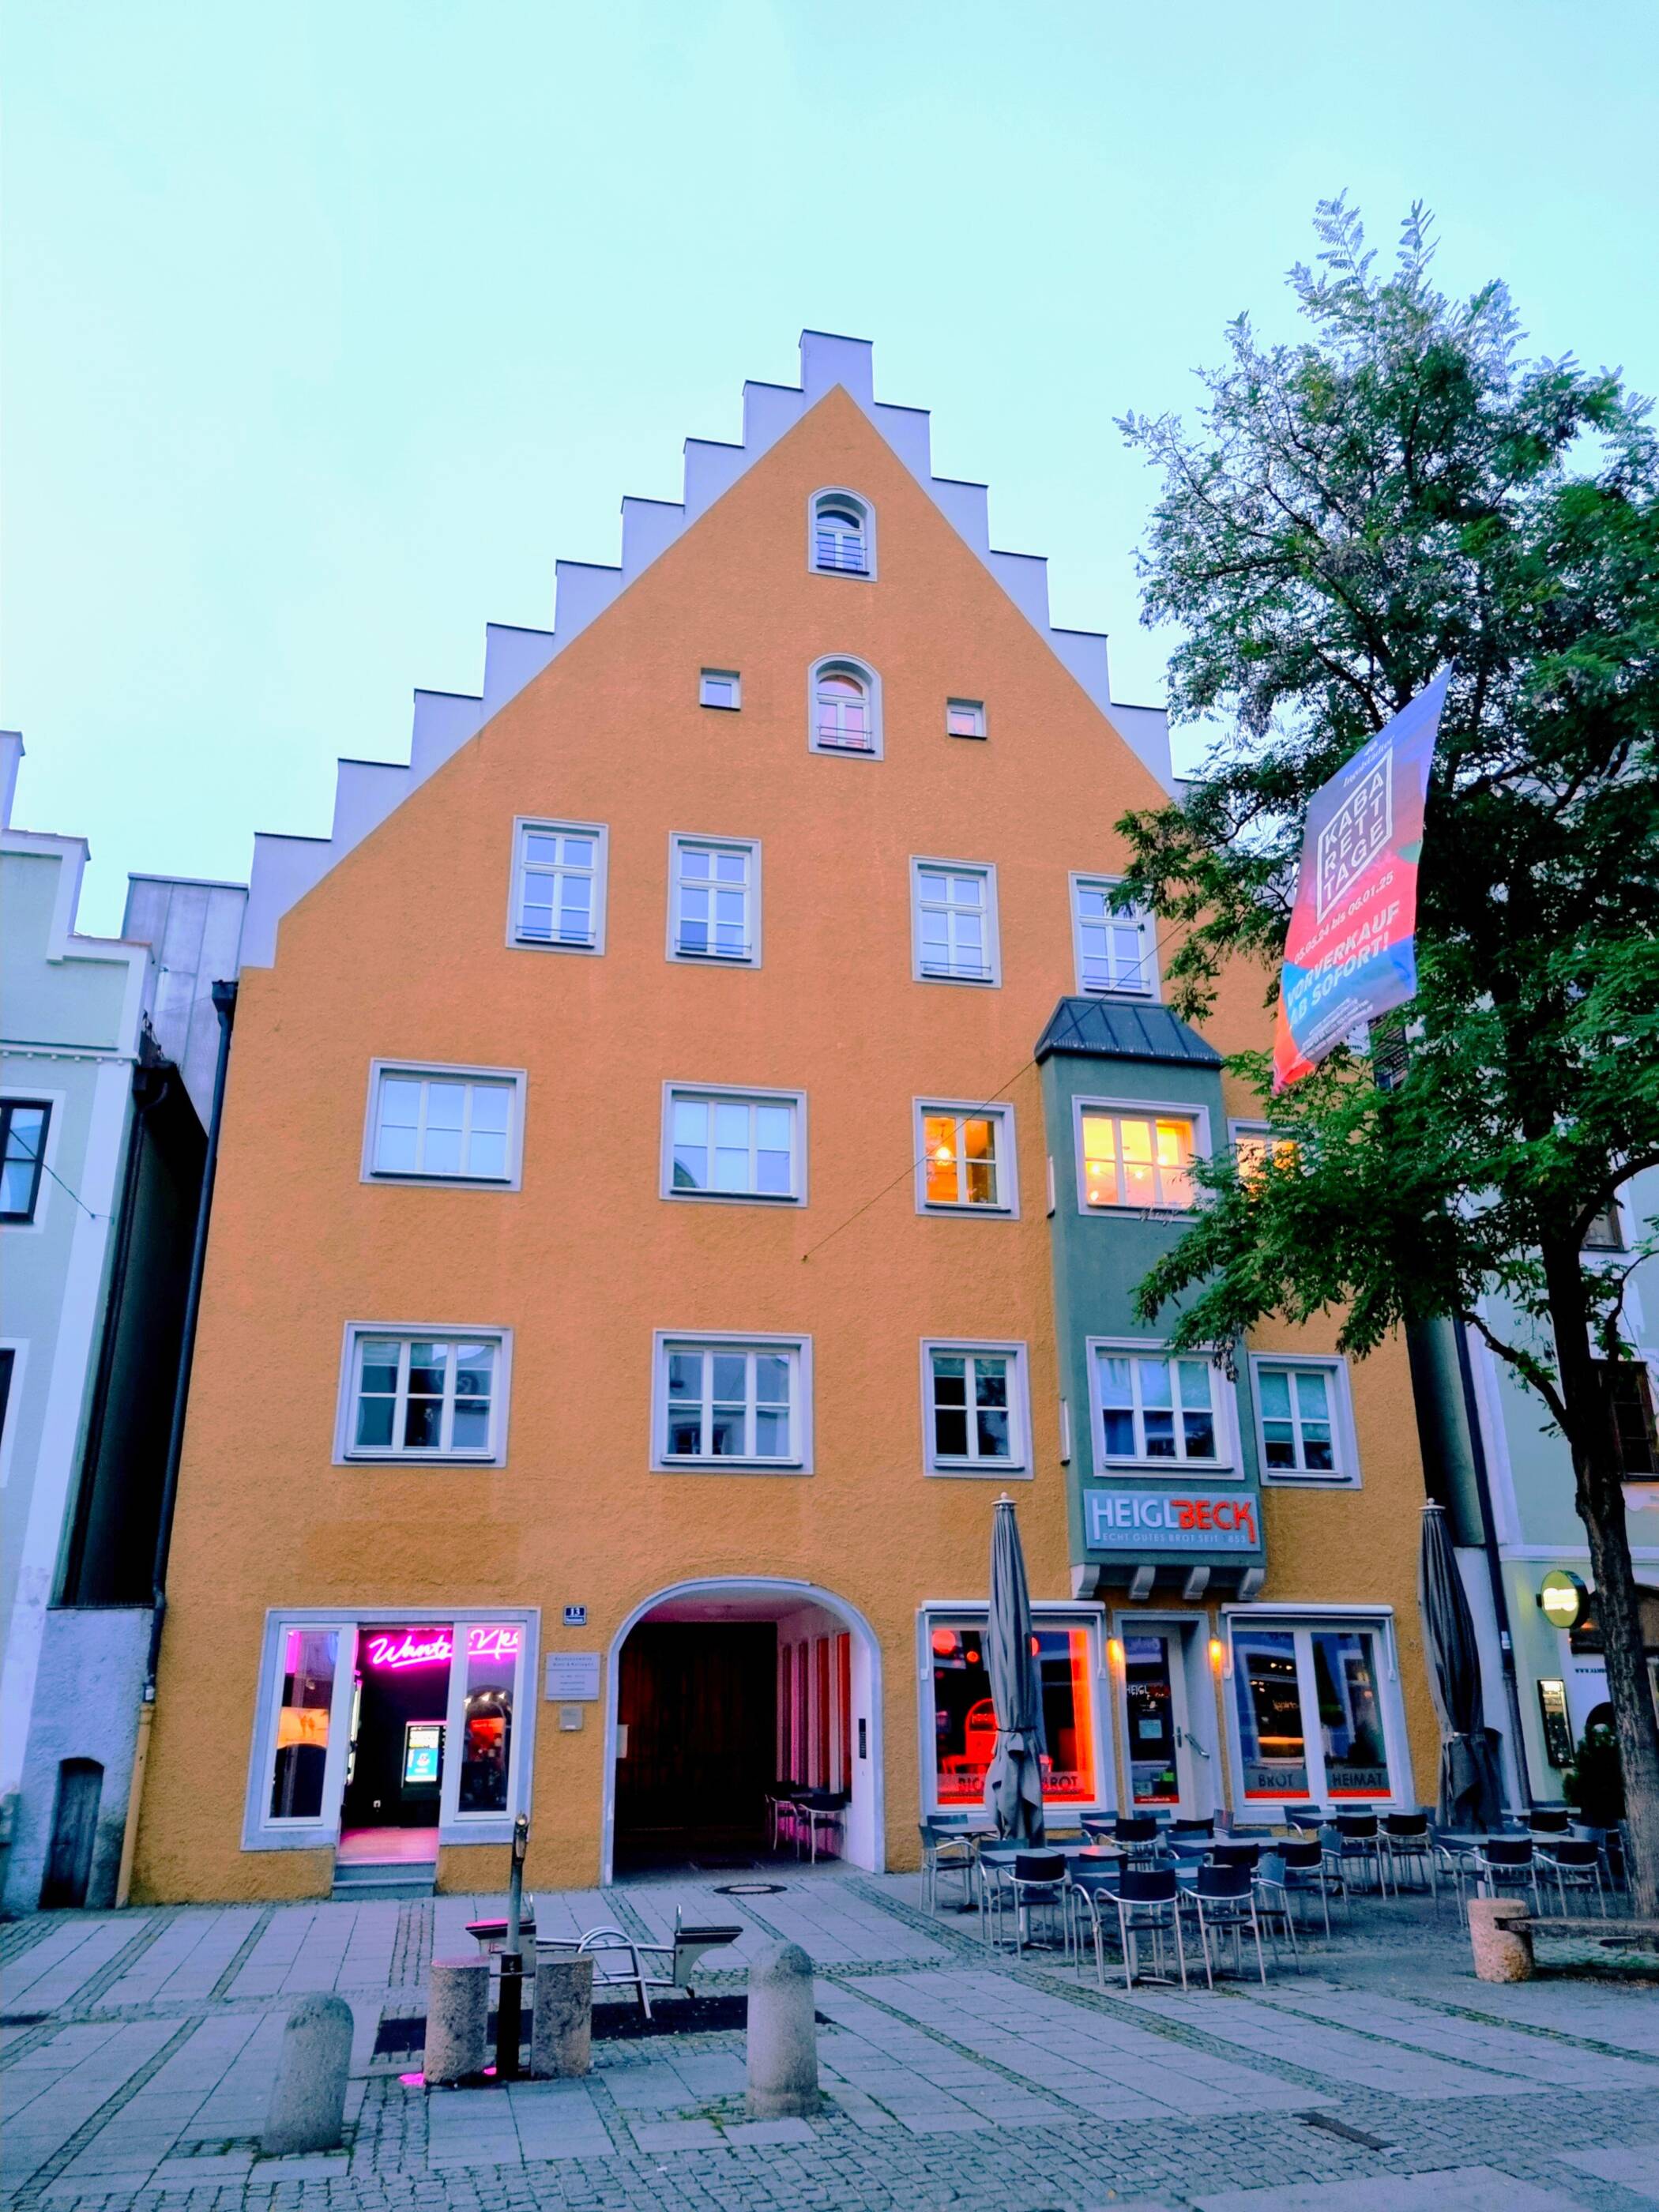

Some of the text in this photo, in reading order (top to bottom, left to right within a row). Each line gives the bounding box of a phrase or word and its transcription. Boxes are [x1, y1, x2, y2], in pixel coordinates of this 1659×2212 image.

[1325, 791, 1384, 879] RETT
[1326, 771, 1384, 854] KABA
[1324, 815, 1383, 901] TAGE
[1288, 901, 1400, 1007] VORVERKAUF
[1289, 998, 1307, 1030] AB
[1311, 931, 1390, 1006] SOFORT!
[1102, 1533, 1129, 1541] ECHT
[1133, 1533, 1165, 1542] GUTES
[1168, 1533, 1194, 1542] BROT
[1198, 1534, 1218, 1543] SEIT
[570, 1607, 581, 1616] 13
[1258, 1773, 1382, 1787] BROT HEIMAT
